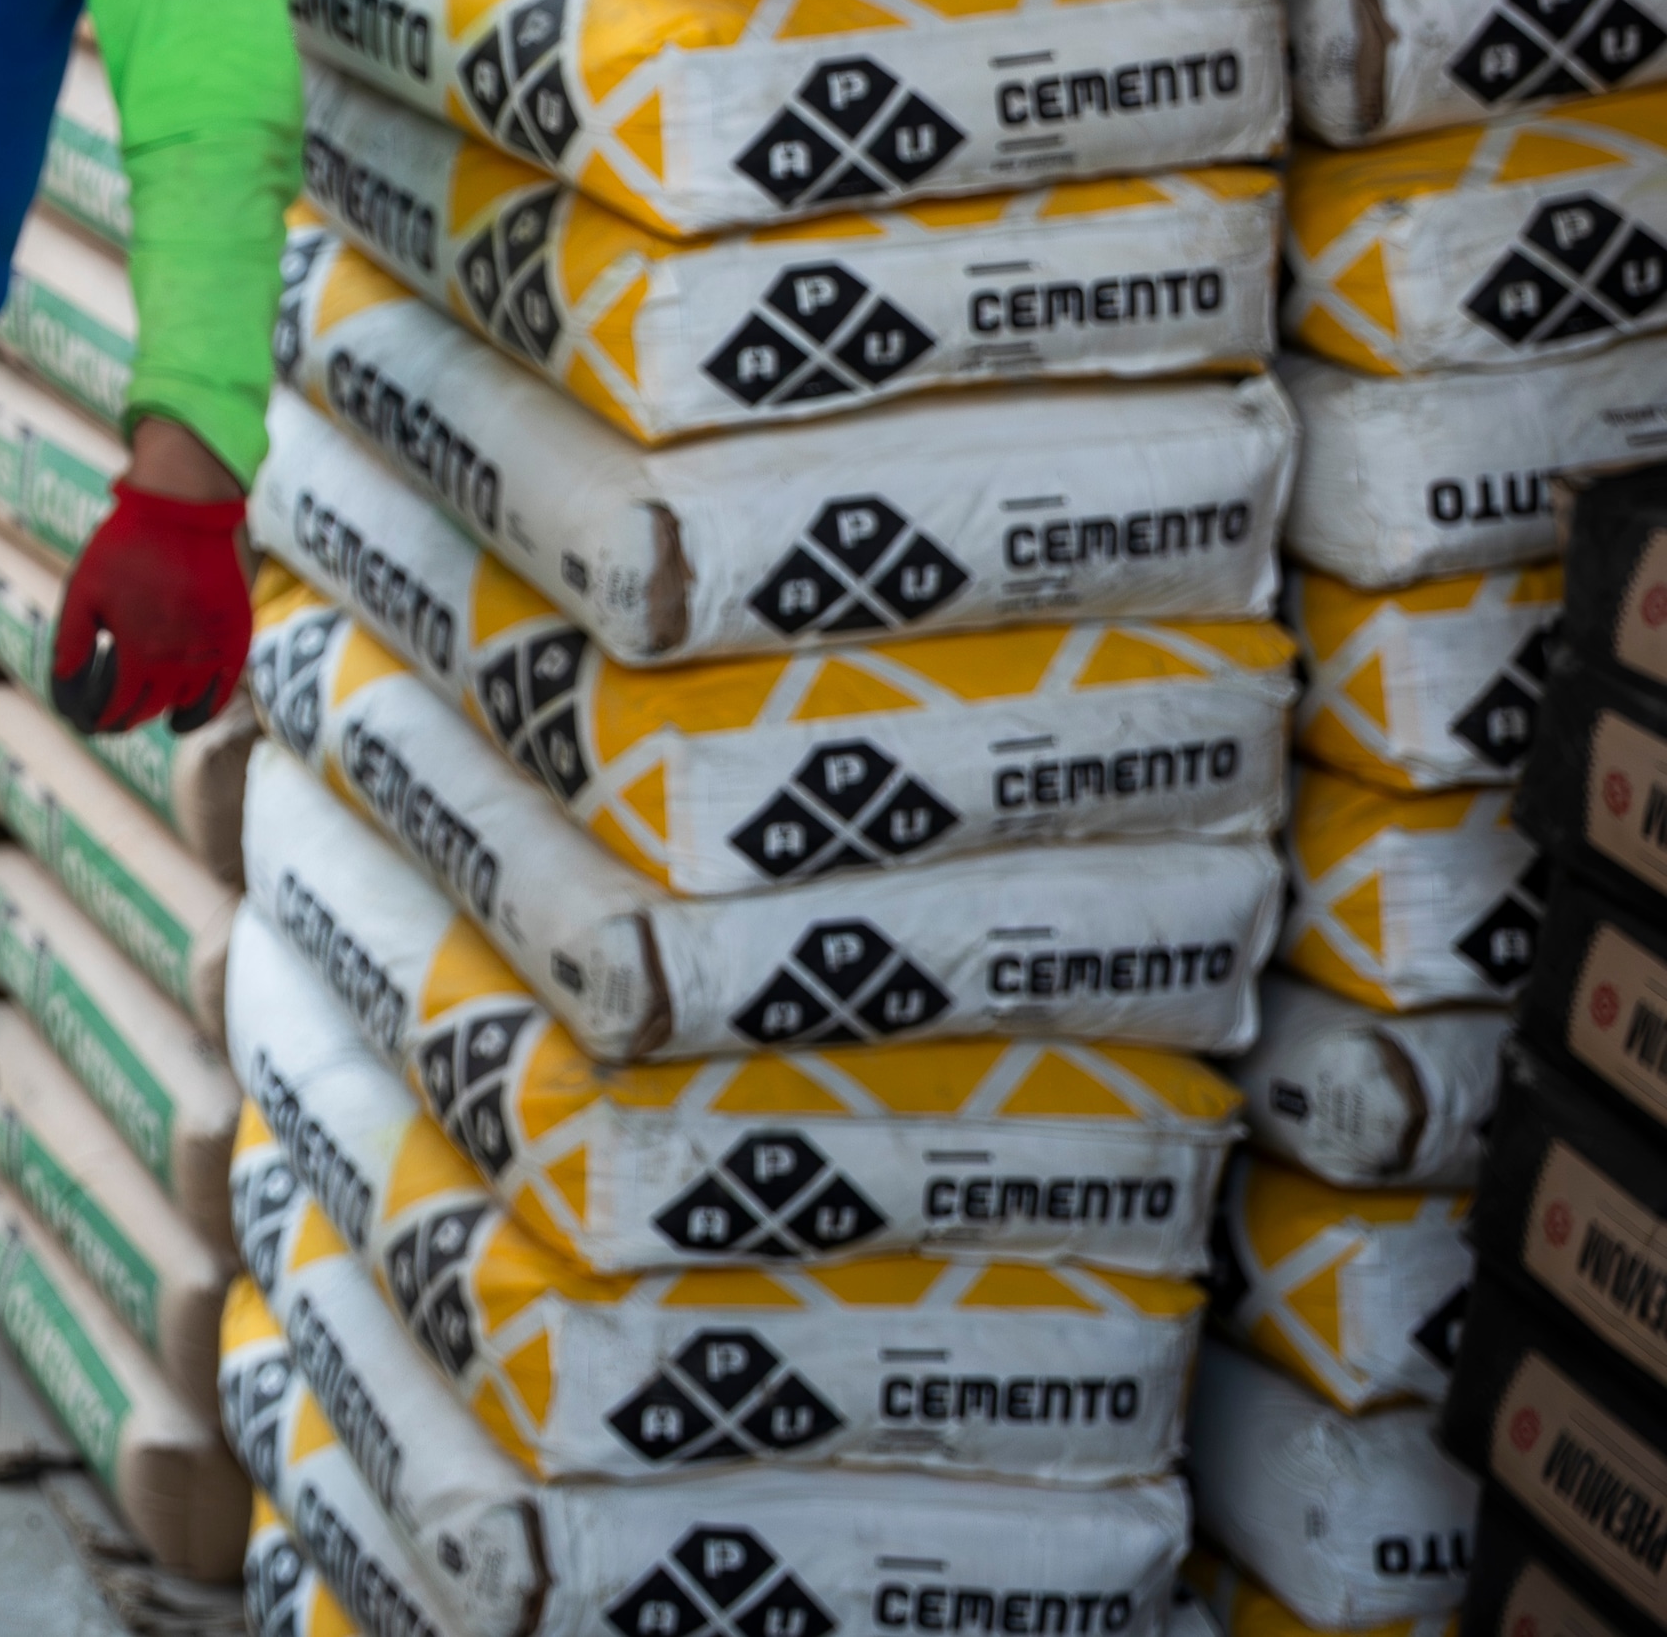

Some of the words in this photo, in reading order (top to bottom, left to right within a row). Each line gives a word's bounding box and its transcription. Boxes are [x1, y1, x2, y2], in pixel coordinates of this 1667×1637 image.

[995, 47, 1245, 128] CEMENTO
[303, 132, 437, 274] EMENTO
[969, 268, 1225, 337] CEMENTO
[1001, 500, 1253, 573] CEMENTO
[293, 487, 459, 674] CEMENTO
[992, 737, 1241, 811] CEMENTO
[985, 940, 1238, 999] CEMENTO
[921, 1176, 1178, 1227] CEMENTO
[879, 1374, 1142, 1426] CEMENTO
[1541, 1431, 1667, 1576] PREMIUM
[874, 1584, 1134, 1637] CEMENTO
